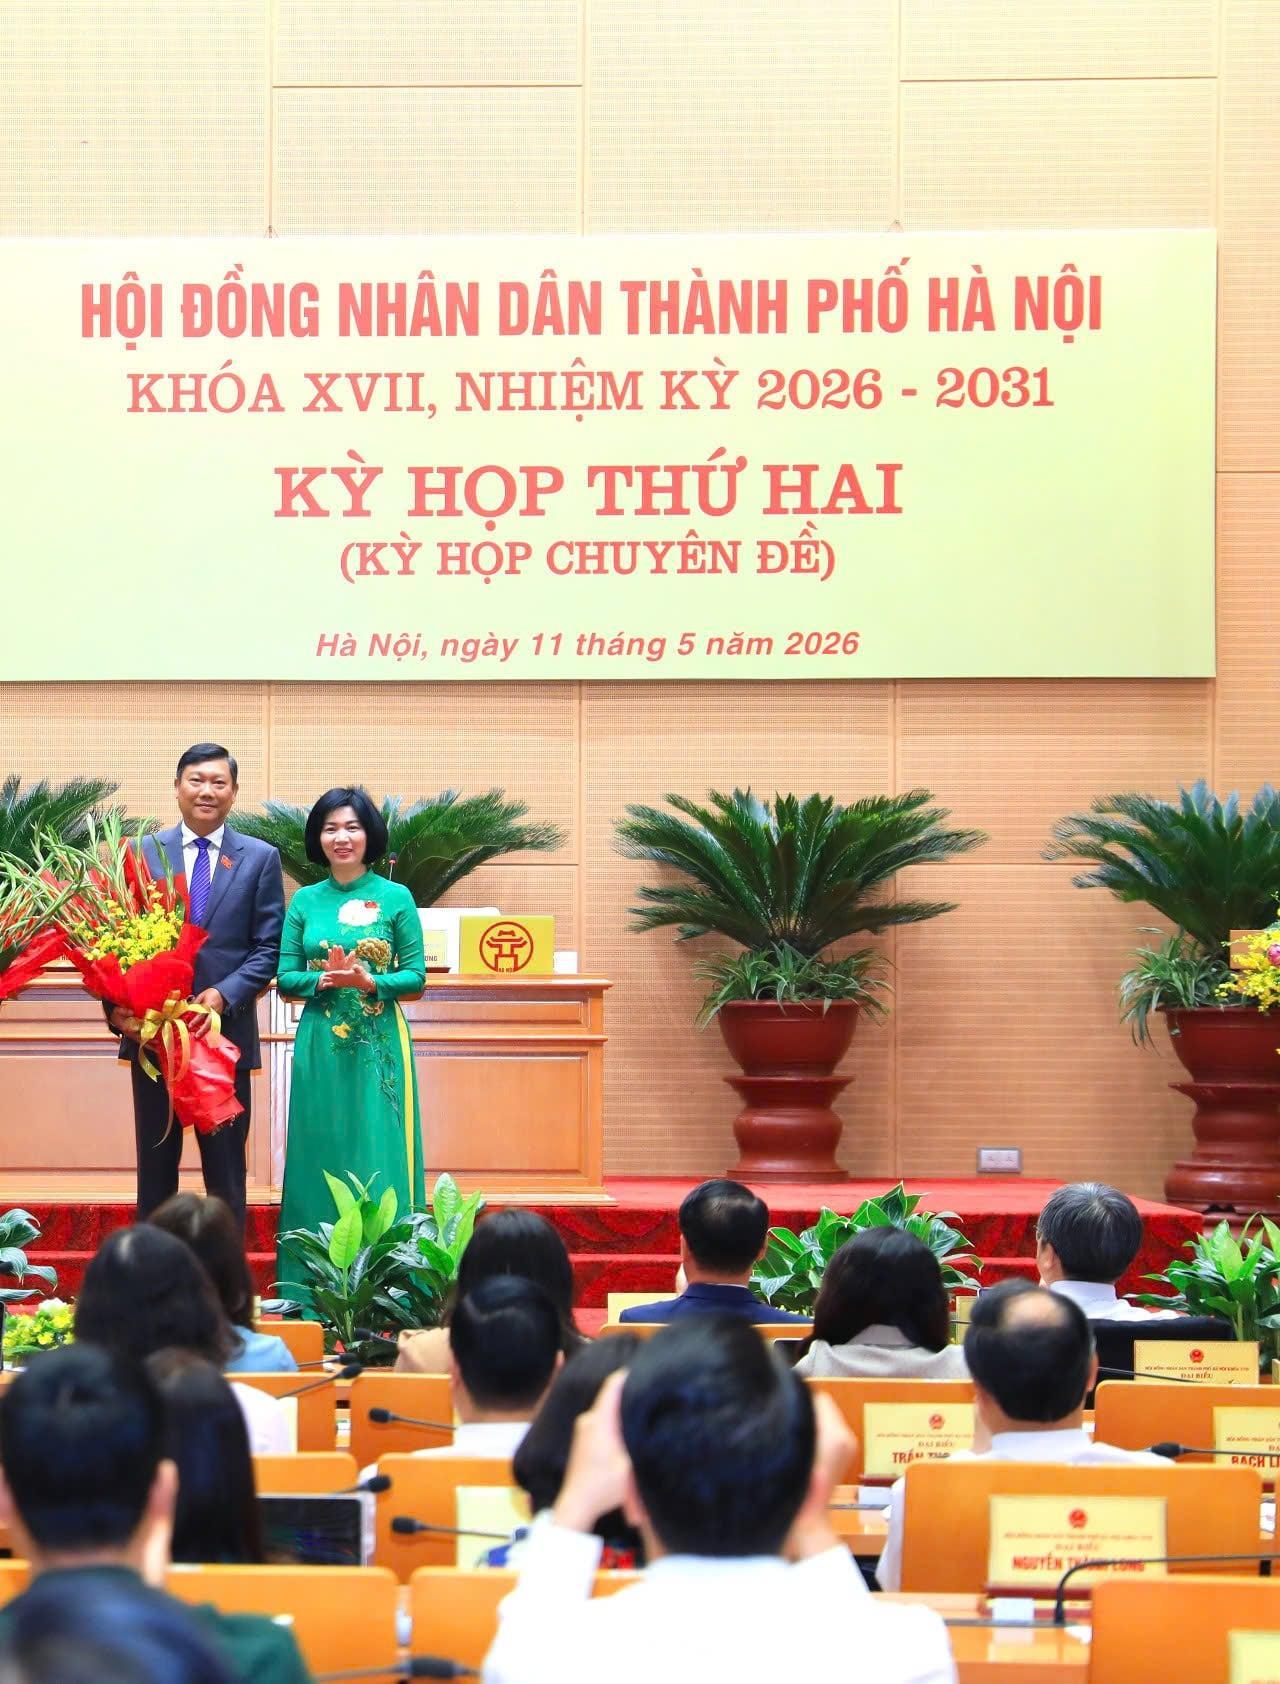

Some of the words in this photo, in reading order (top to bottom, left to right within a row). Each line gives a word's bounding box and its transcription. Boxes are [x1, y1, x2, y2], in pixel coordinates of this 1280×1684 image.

[81, 271, 163, 351] HỘI
[180, 264, 319, 338] ĐỒNG
[339, 271, 479, 337] NHÂN
[499, 269, 602, 336] DÂN
[620, 268, 788, 336] THÀNH
[807, 258, 910, 334] PHỐ
[928, 265, 996, 333] HÀ
[1014, 263, 1102, 344] NỘI
[128, 359, 285, 414] KHÓA
[303, 372, 436, 415] XVII,
[458, 358, 643, 421] NHIỆM
[660, 357, 738, 410] KỲ
[757, 368, 883, 410] 2026
[936, 366, 1053, 409] 2031
[274, 449, 383, 517] KỲ
[407, 464, 564, 532] HỌP
[587, 446, 748, 517] THỨ
[762, 463, 903, 515] HAI
[340, 530, 423, 584] (KỲ
[436, 541, 533, 584] HỌP
[546, 529, 742, 576] CHUYÊN
[756, 520, 836, 582] ĐỀ)
[316, 634, 357, 657] Hà
[368, 633, 427, 661] Nội,
[440, 634, 518, 663] ngày
[532, 634, 563, 656] 11
[576, 632, 667, 662] tháng
[677, 632, 696, 656] 5
[706, 633, 774, 656] năm
[785, 631, 860, 656] 2026
